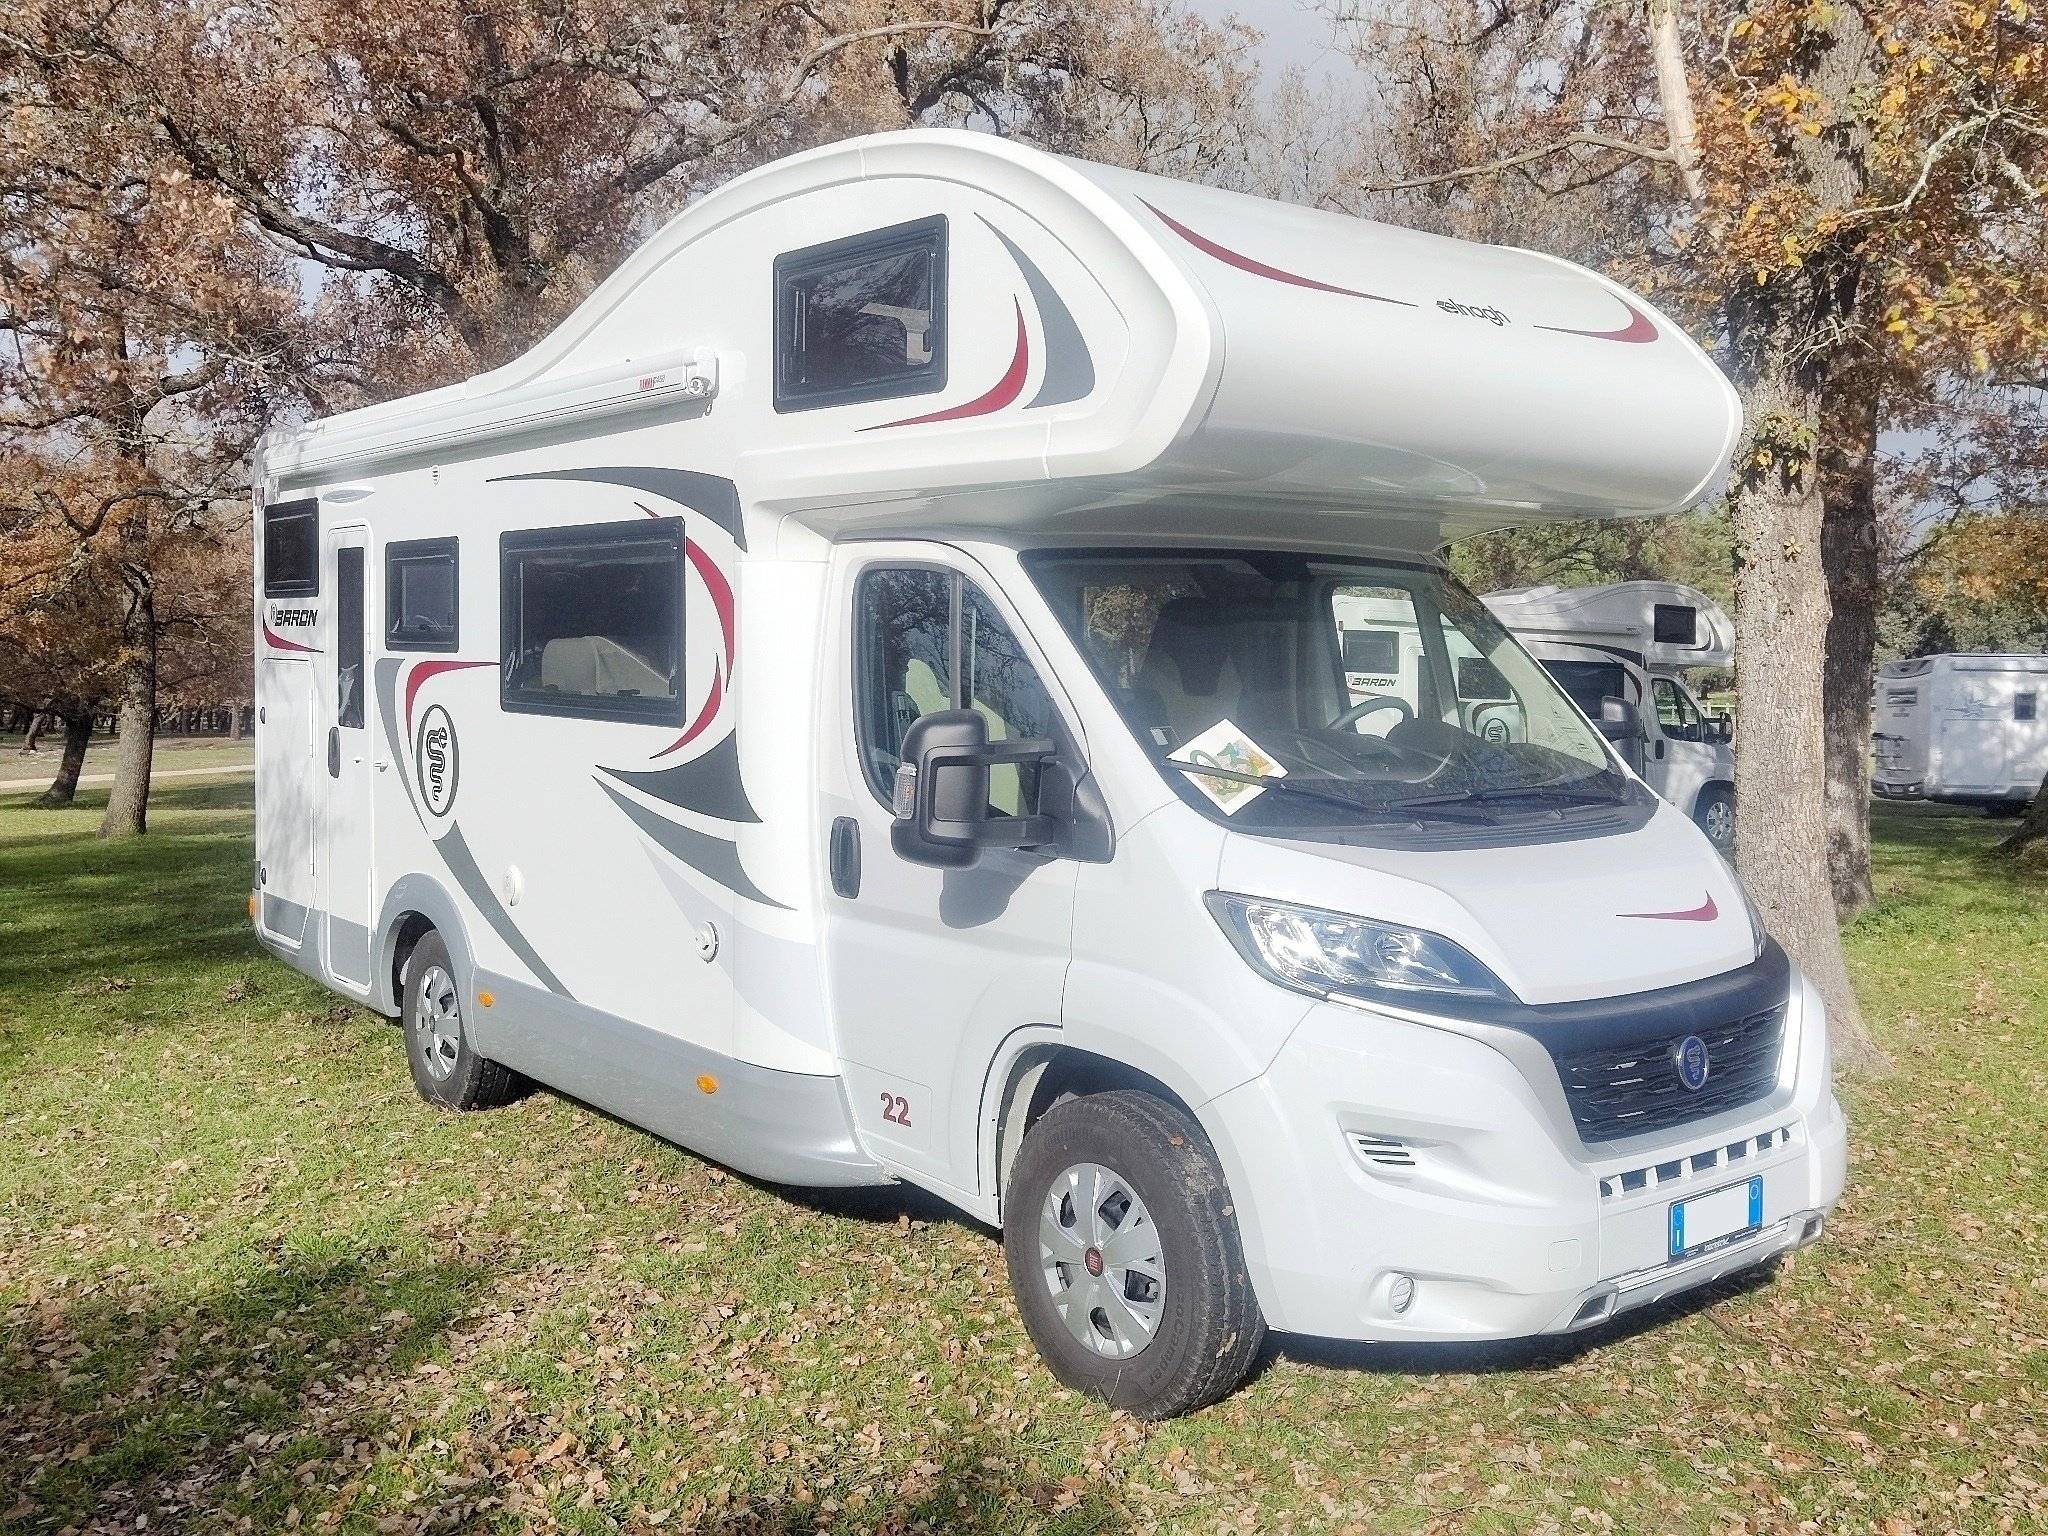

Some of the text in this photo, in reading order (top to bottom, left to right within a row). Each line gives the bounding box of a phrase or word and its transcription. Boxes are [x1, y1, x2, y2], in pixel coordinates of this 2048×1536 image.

[1436, 298, 1511, 326] elnagh
[275, 609, 318, 626] BARON
[1352, 677, 1396, 687] BARON
[881, 1092, 911, 1127] 22
